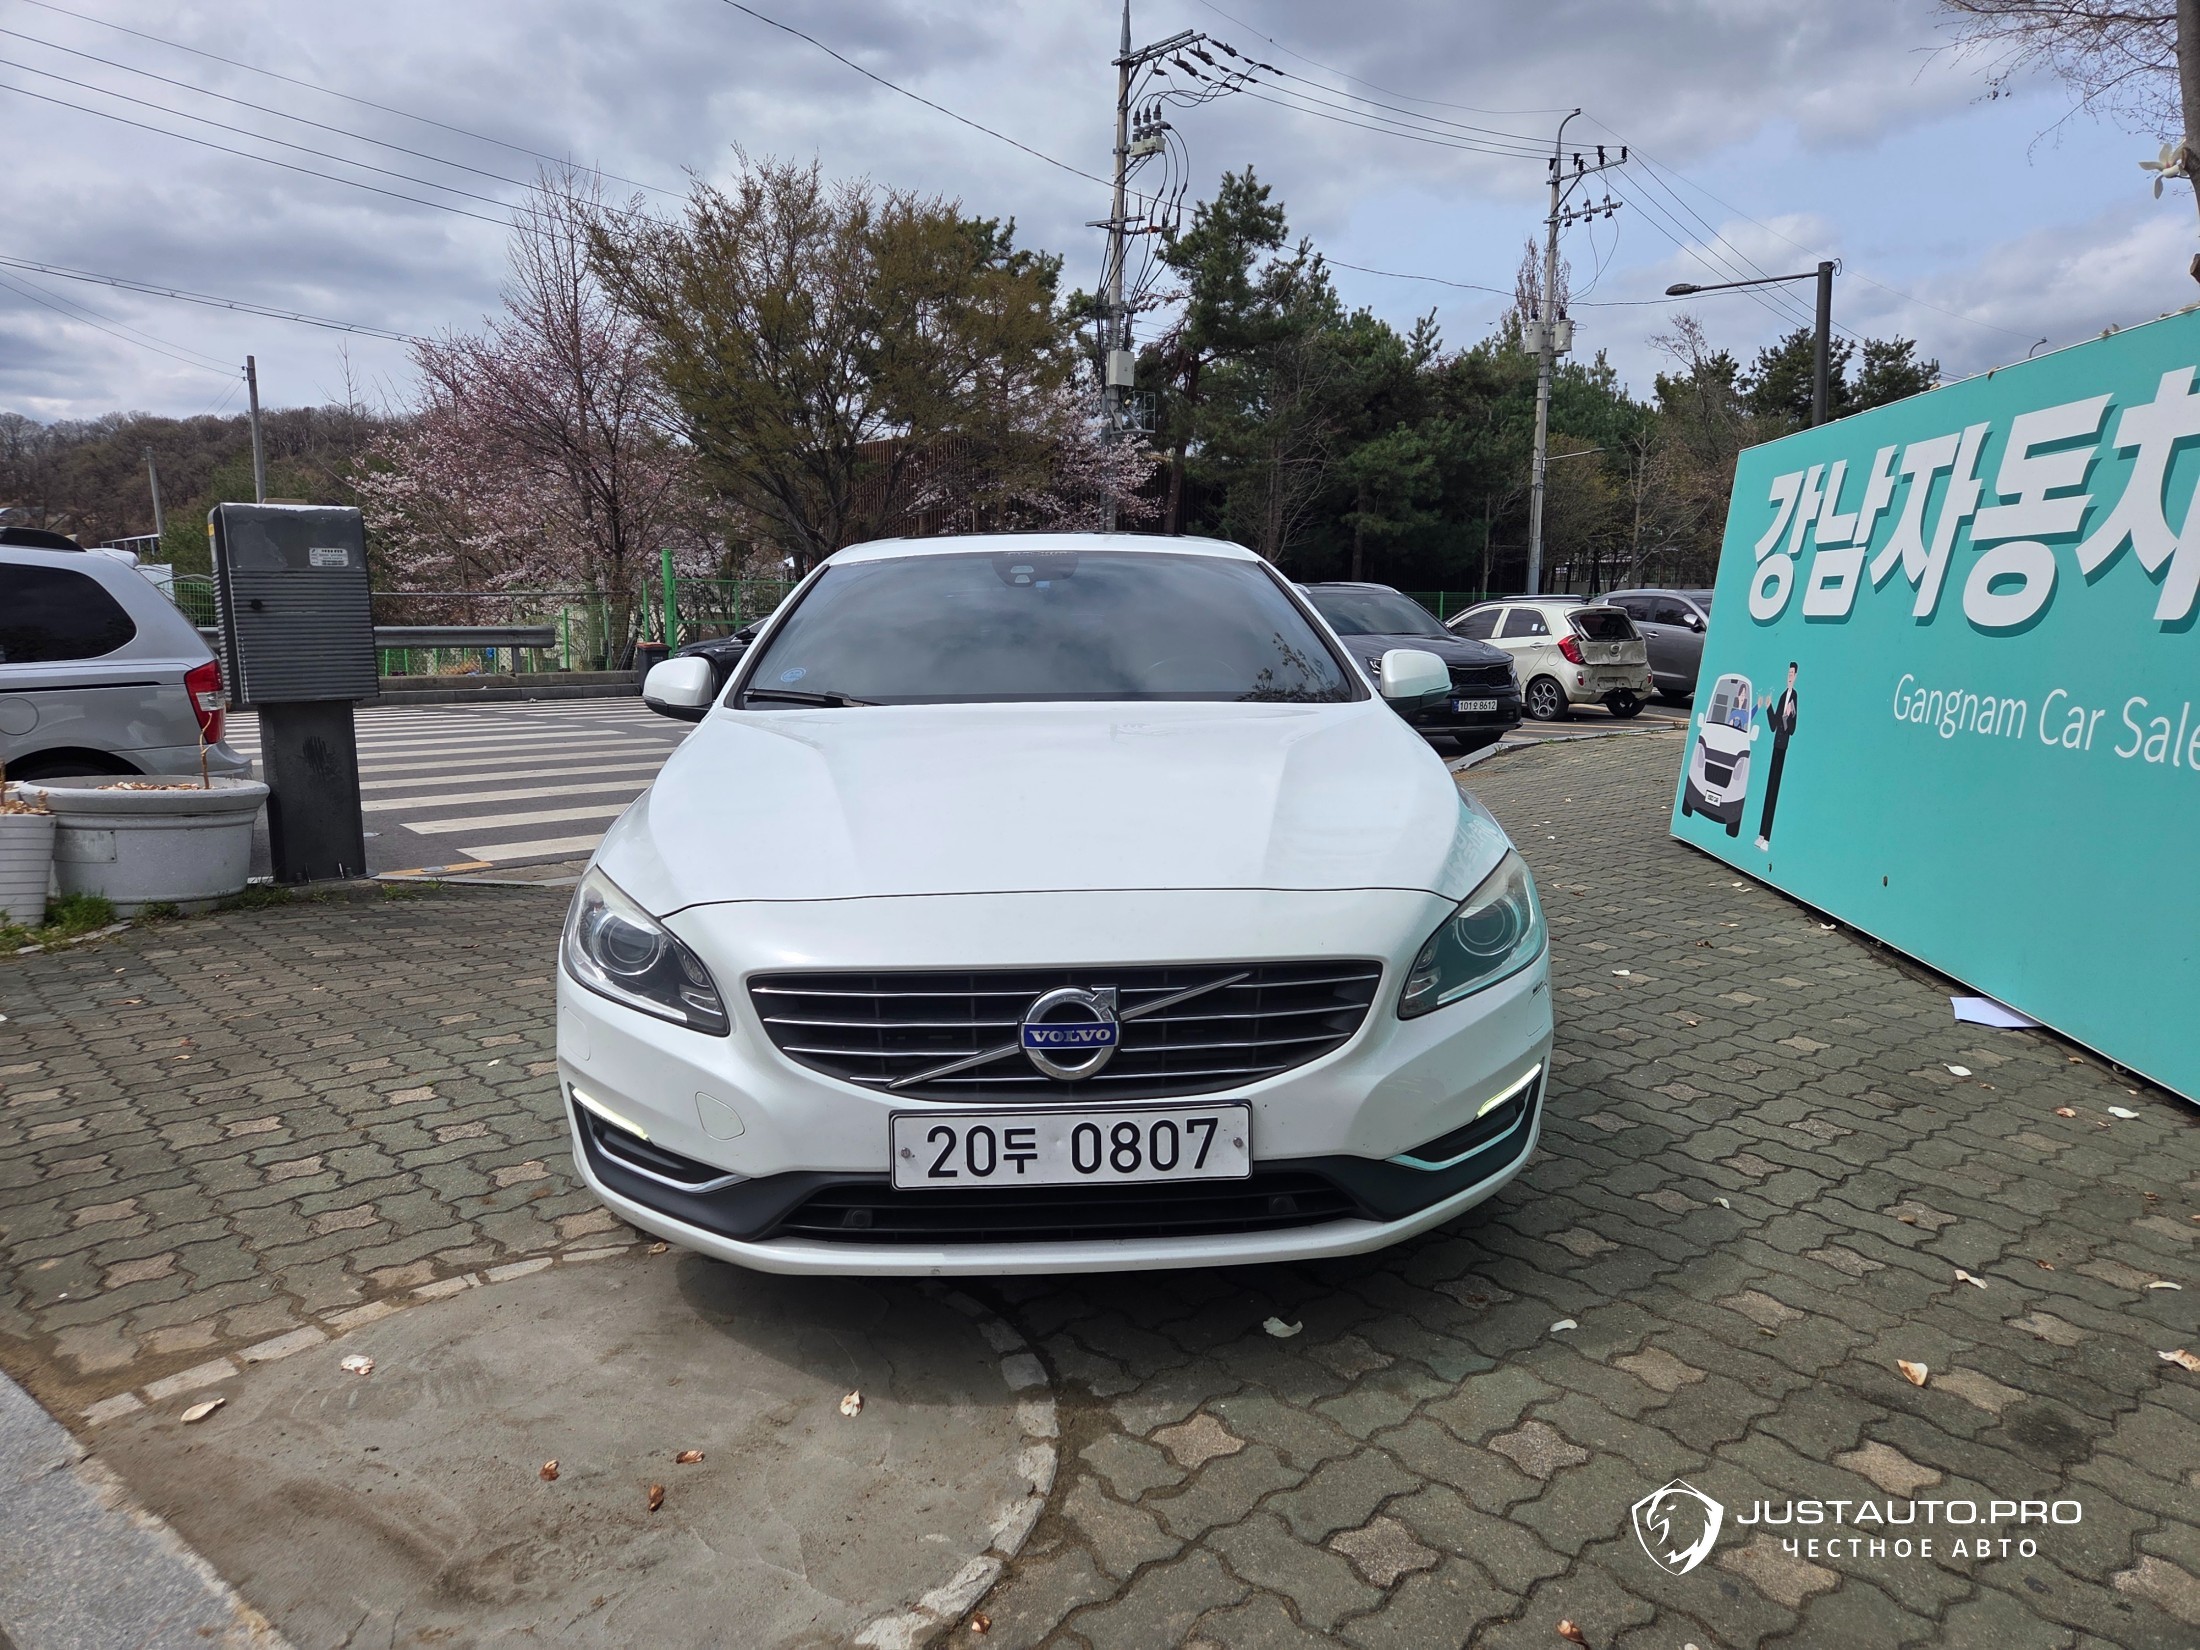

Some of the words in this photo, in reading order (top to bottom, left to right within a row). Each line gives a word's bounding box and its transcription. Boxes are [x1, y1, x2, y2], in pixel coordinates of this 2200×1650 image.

[1479, 700, 1496, 710] 8612
[1893, 673, 2027, 739] Gangnam
[2039, 688, 2105, 751] Car
[1029, 1028, 1111, 1043] VOLVO
[926, 1124, 1038, 1179] 20두
[1070, 1117, 1219, 1175] 0807
